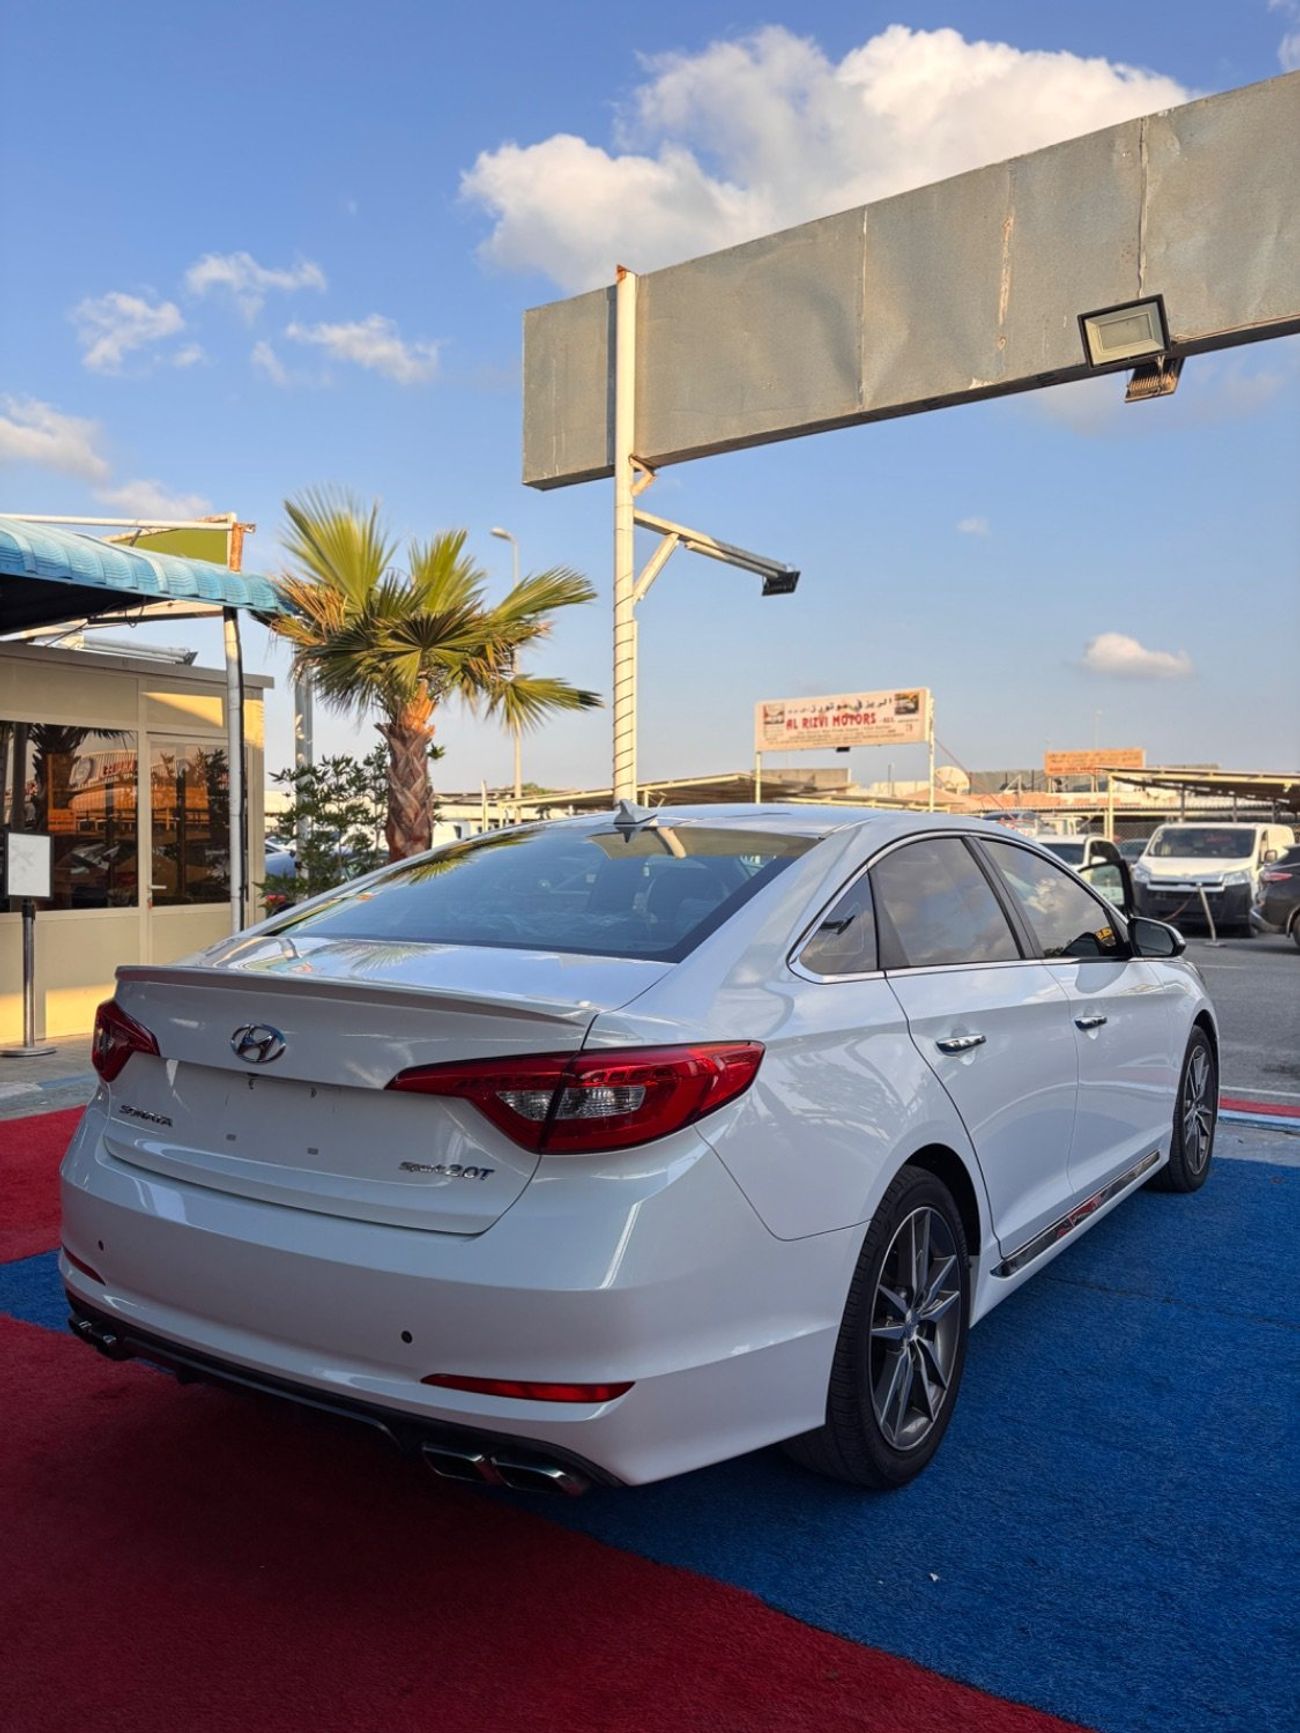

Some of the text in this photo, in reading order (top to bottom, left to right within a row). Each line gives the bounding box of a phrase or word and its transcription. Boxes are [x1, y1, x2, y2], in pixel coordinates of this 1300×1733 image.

[786, 718, 798, 730] AL
[802, 715, 829, 729] RIZVI
[832, 712, 877, 727] MOTORS
[119, 1104, 173, 1128] SONATA
